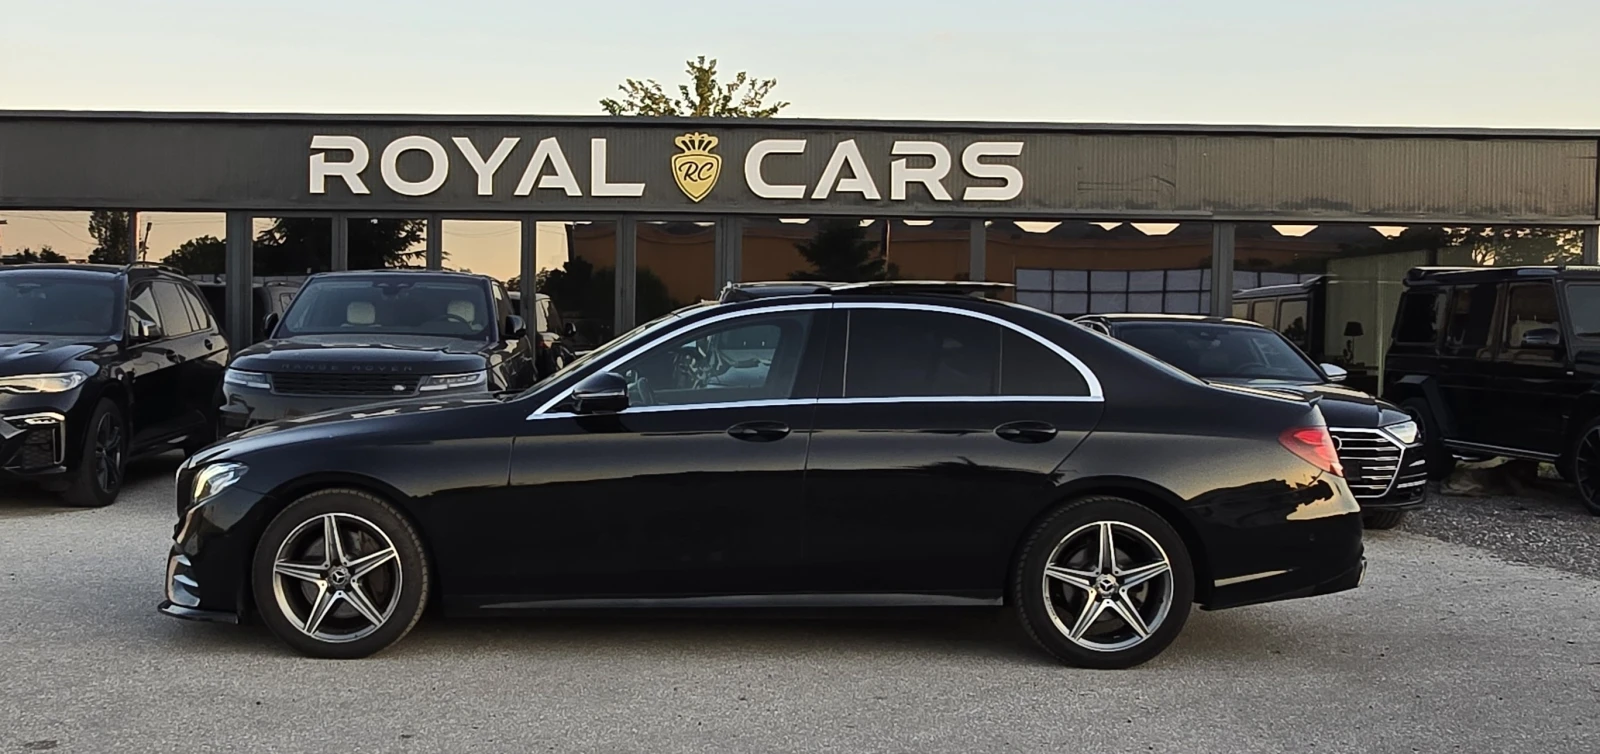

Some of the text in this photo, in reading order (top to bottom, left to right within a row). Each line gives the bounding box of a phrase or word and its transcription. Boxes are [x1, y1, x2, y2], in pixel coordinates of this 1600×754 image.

[309, 135, 1024, 201] ROYAL CARS
[678, 161, 714, 182] RC
